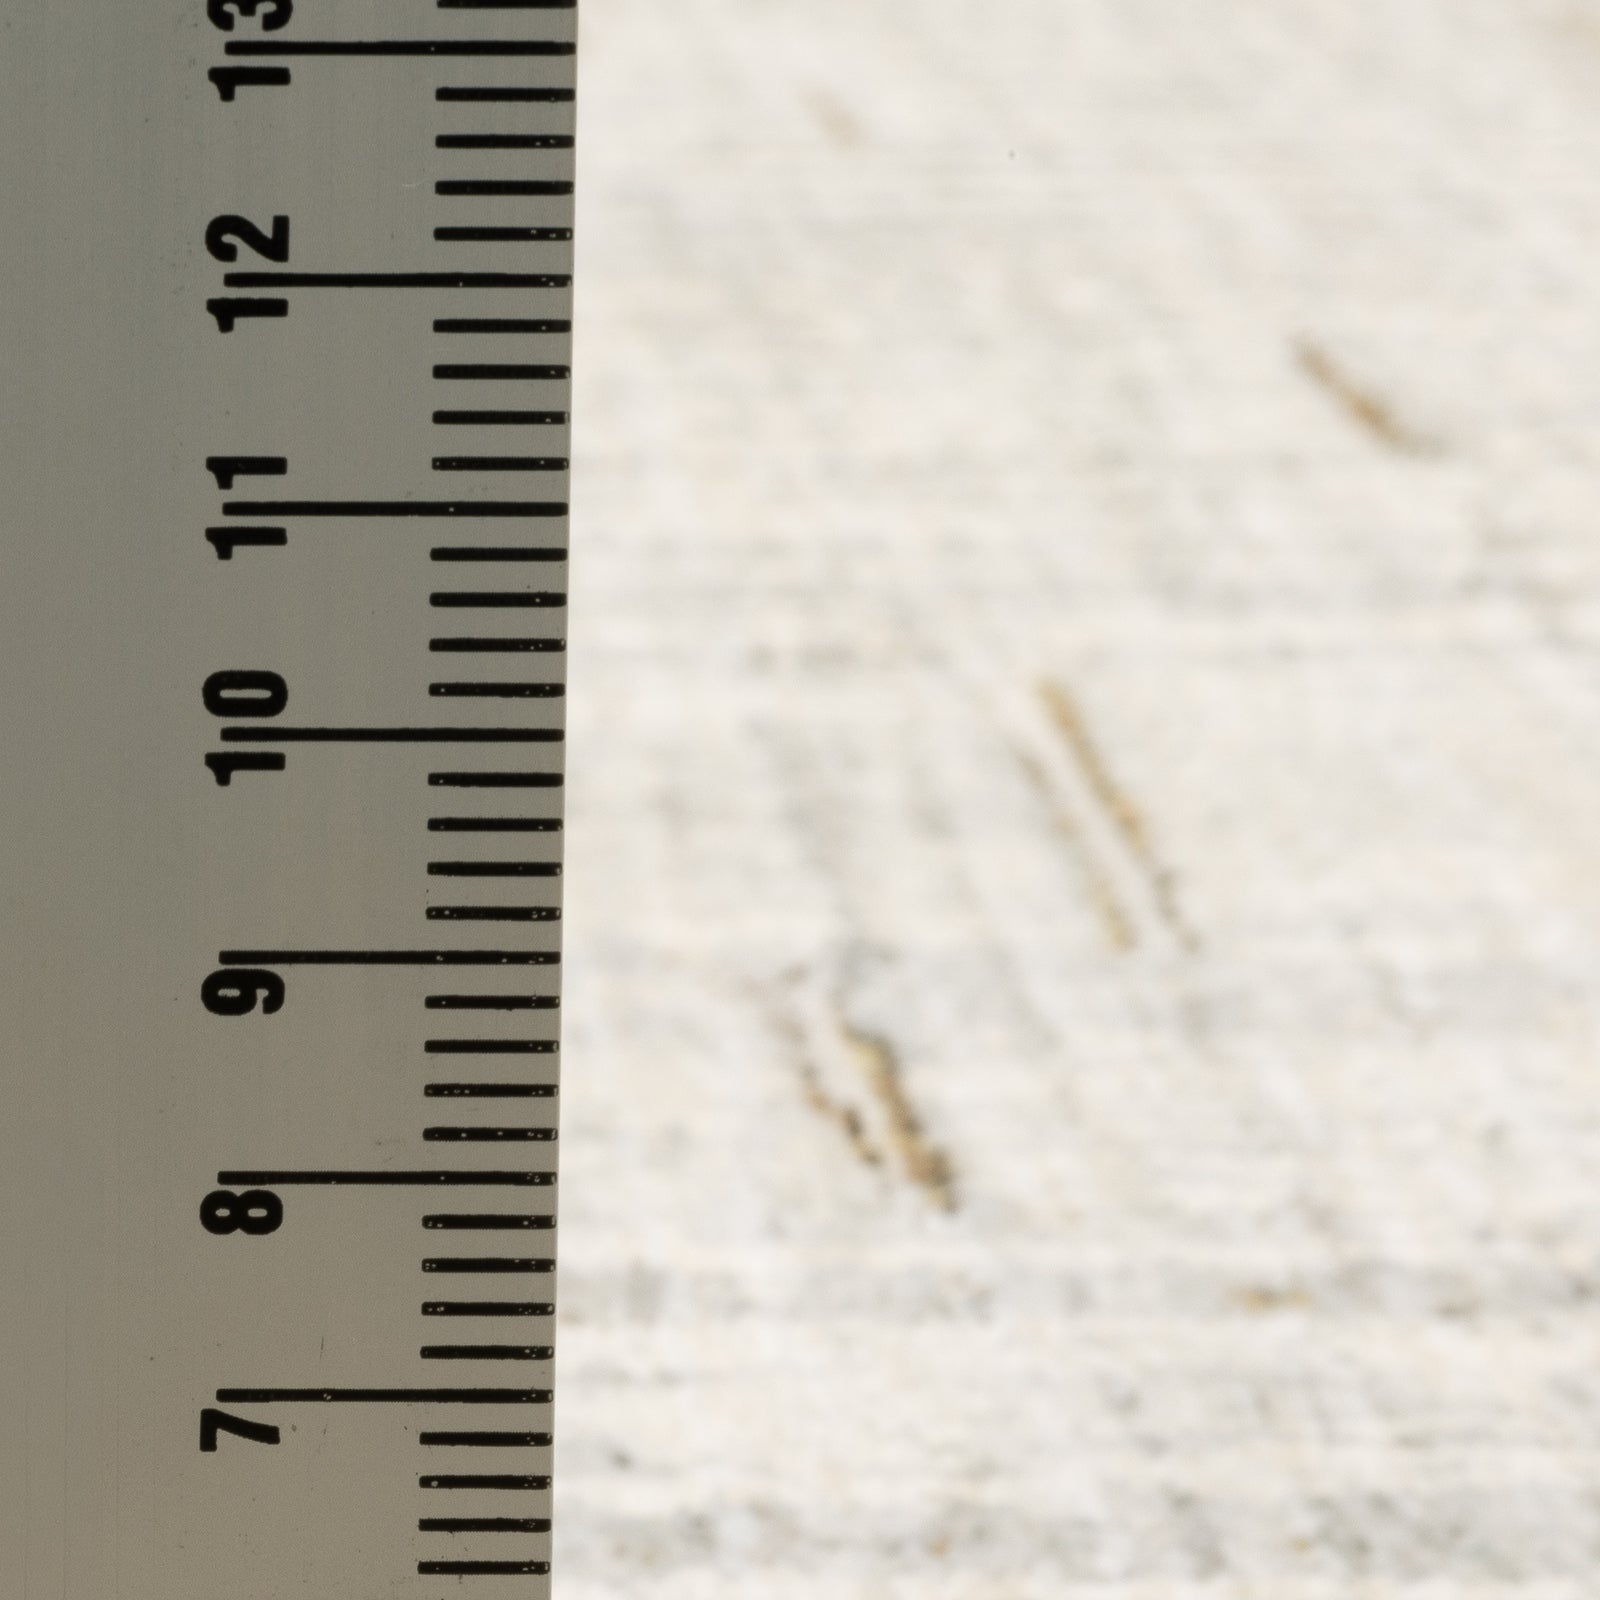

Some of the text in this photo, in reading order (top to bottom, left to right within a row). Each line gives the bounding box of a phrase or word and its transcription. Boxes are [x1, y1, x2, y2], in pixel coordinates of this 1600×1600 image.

[205, 0, 295, 104] 13
[203, 213, 291, 335] 12
[203, 454, 289, 562] 11
[200, 668, 290, 788] 10
[199, 966, 287, 1018] 9
[198, 1187, 285, 1237] 8
[198, 1406, 282, 1454] 7
